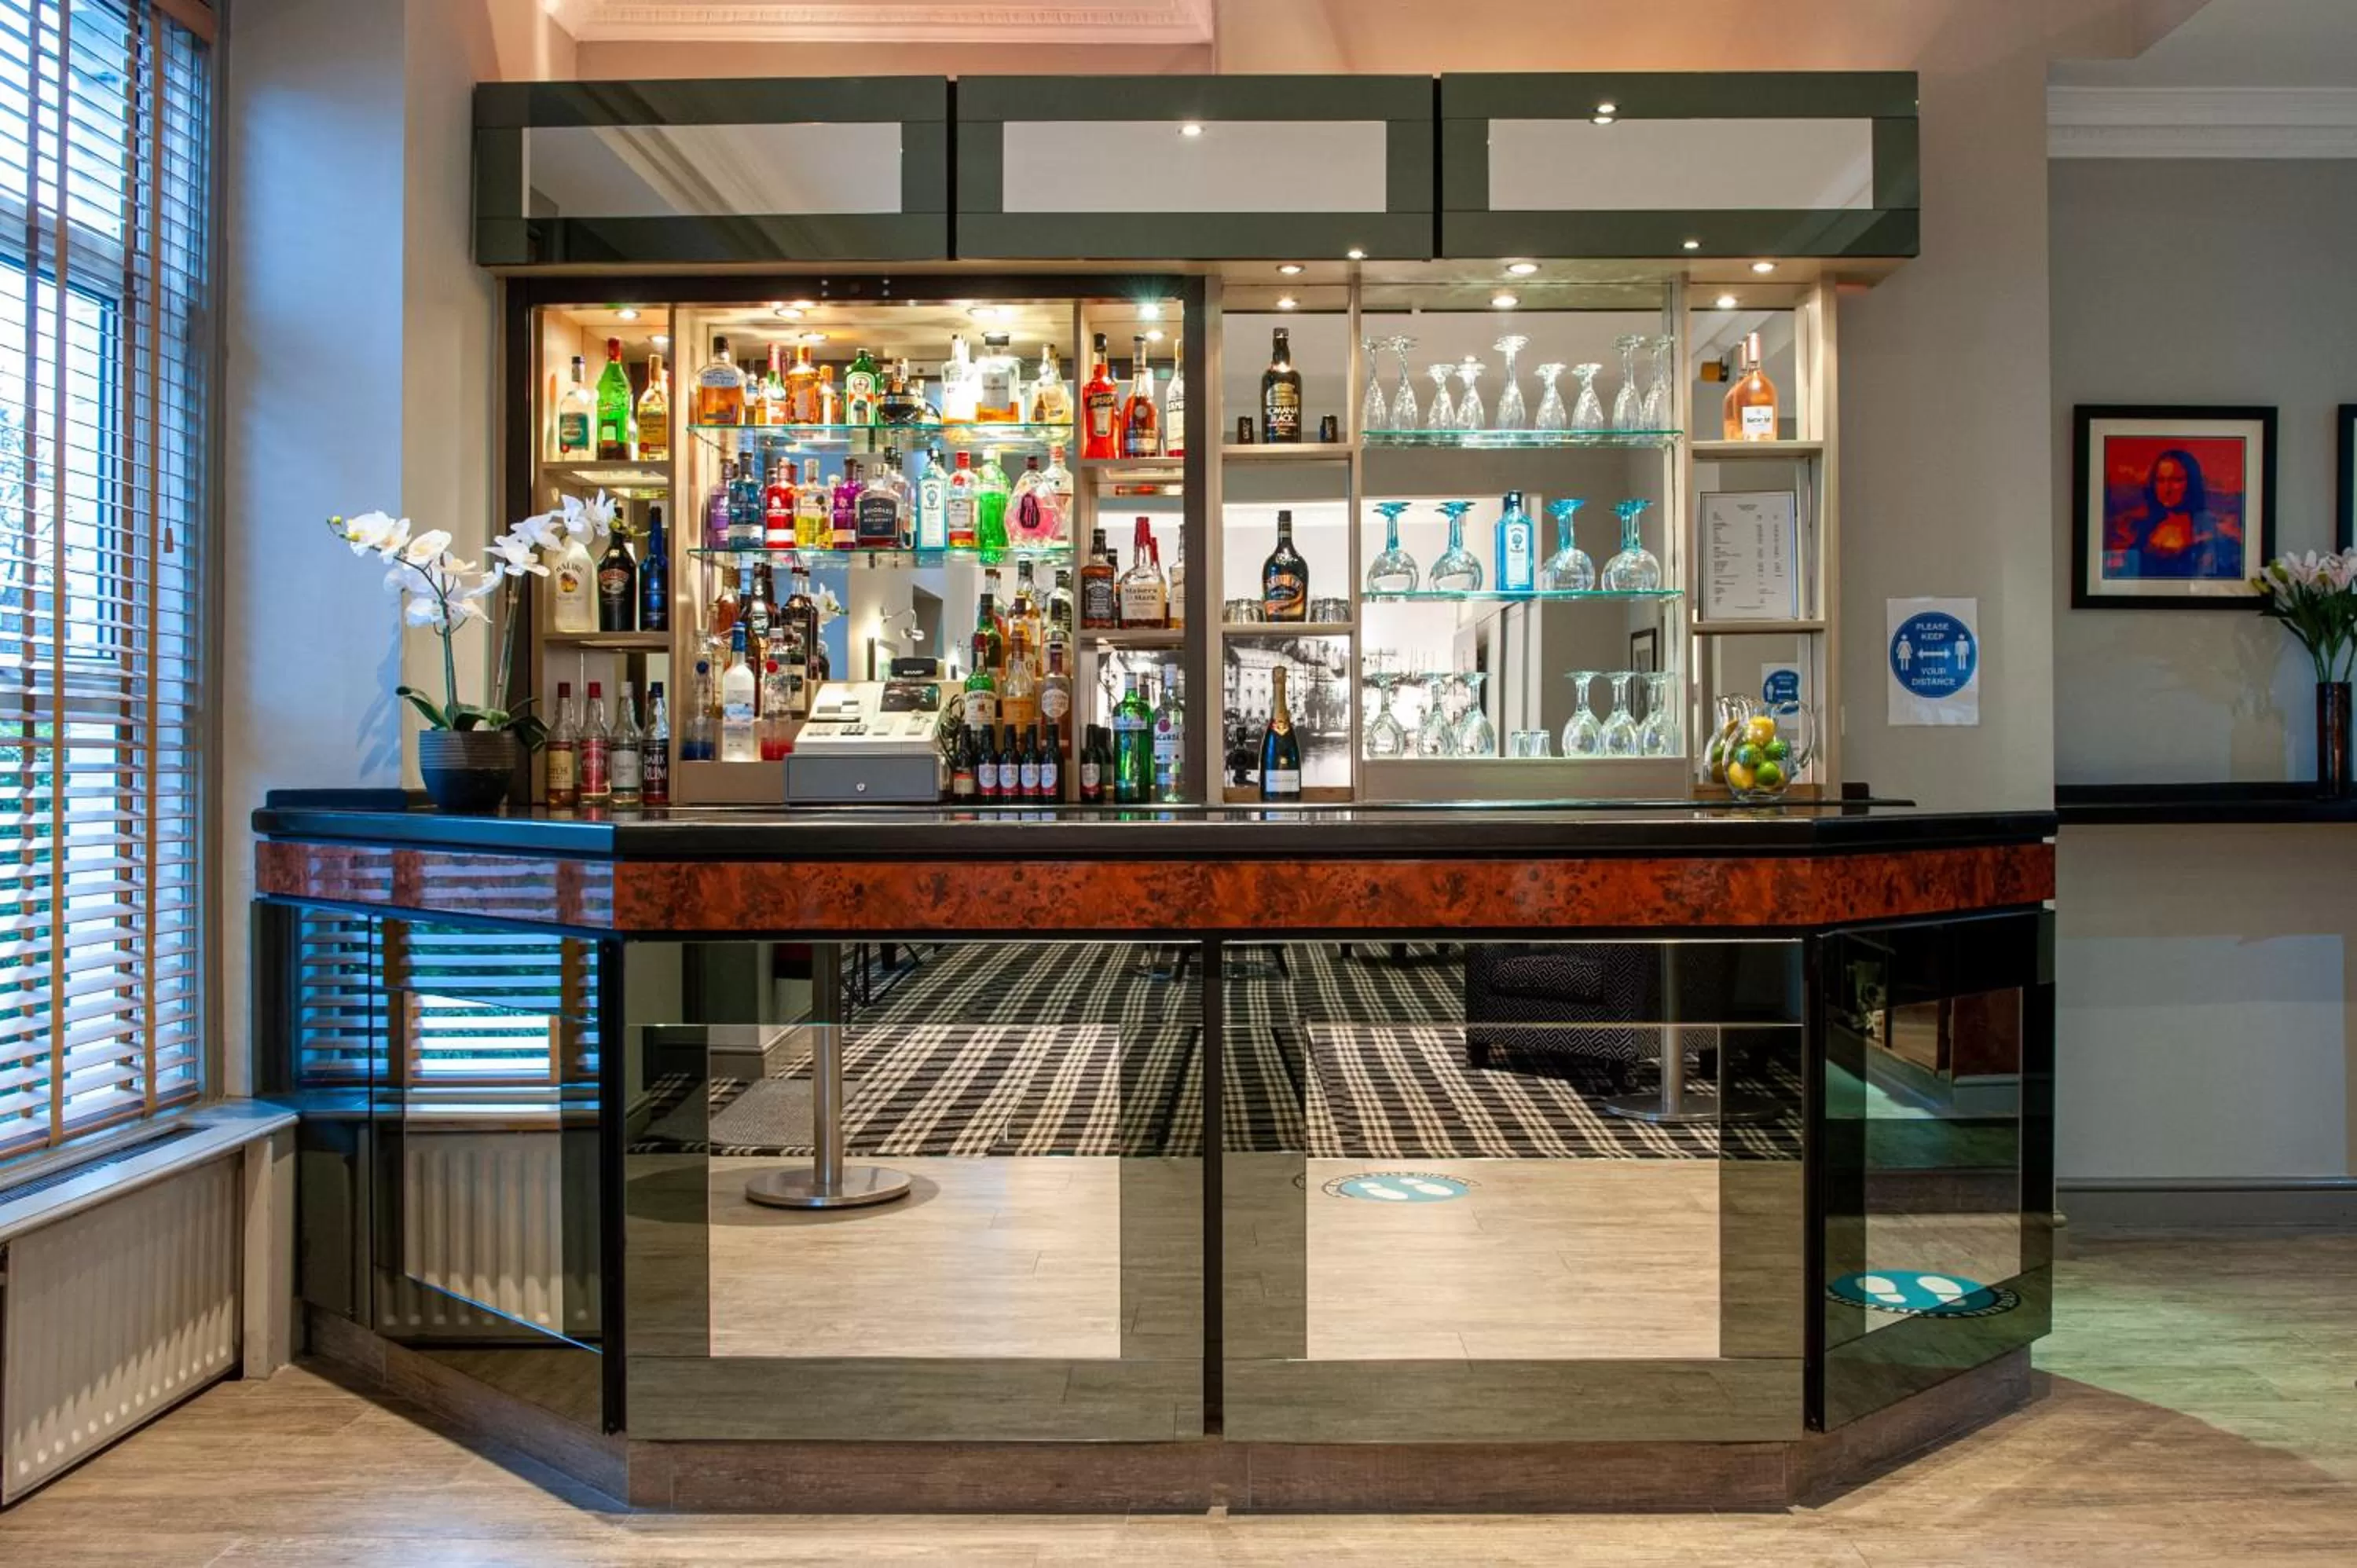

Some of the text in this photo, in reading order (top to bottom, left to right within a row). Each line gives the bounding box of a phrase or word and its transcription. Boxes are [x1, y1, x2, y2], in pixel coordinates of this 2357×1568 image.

[1921, 632, 1945, 641] KEEP
[1921, 667, 1947, 676] YOUR
[643, 753, 665, 765] DARK
[643, 765, 667, 780] RUM
